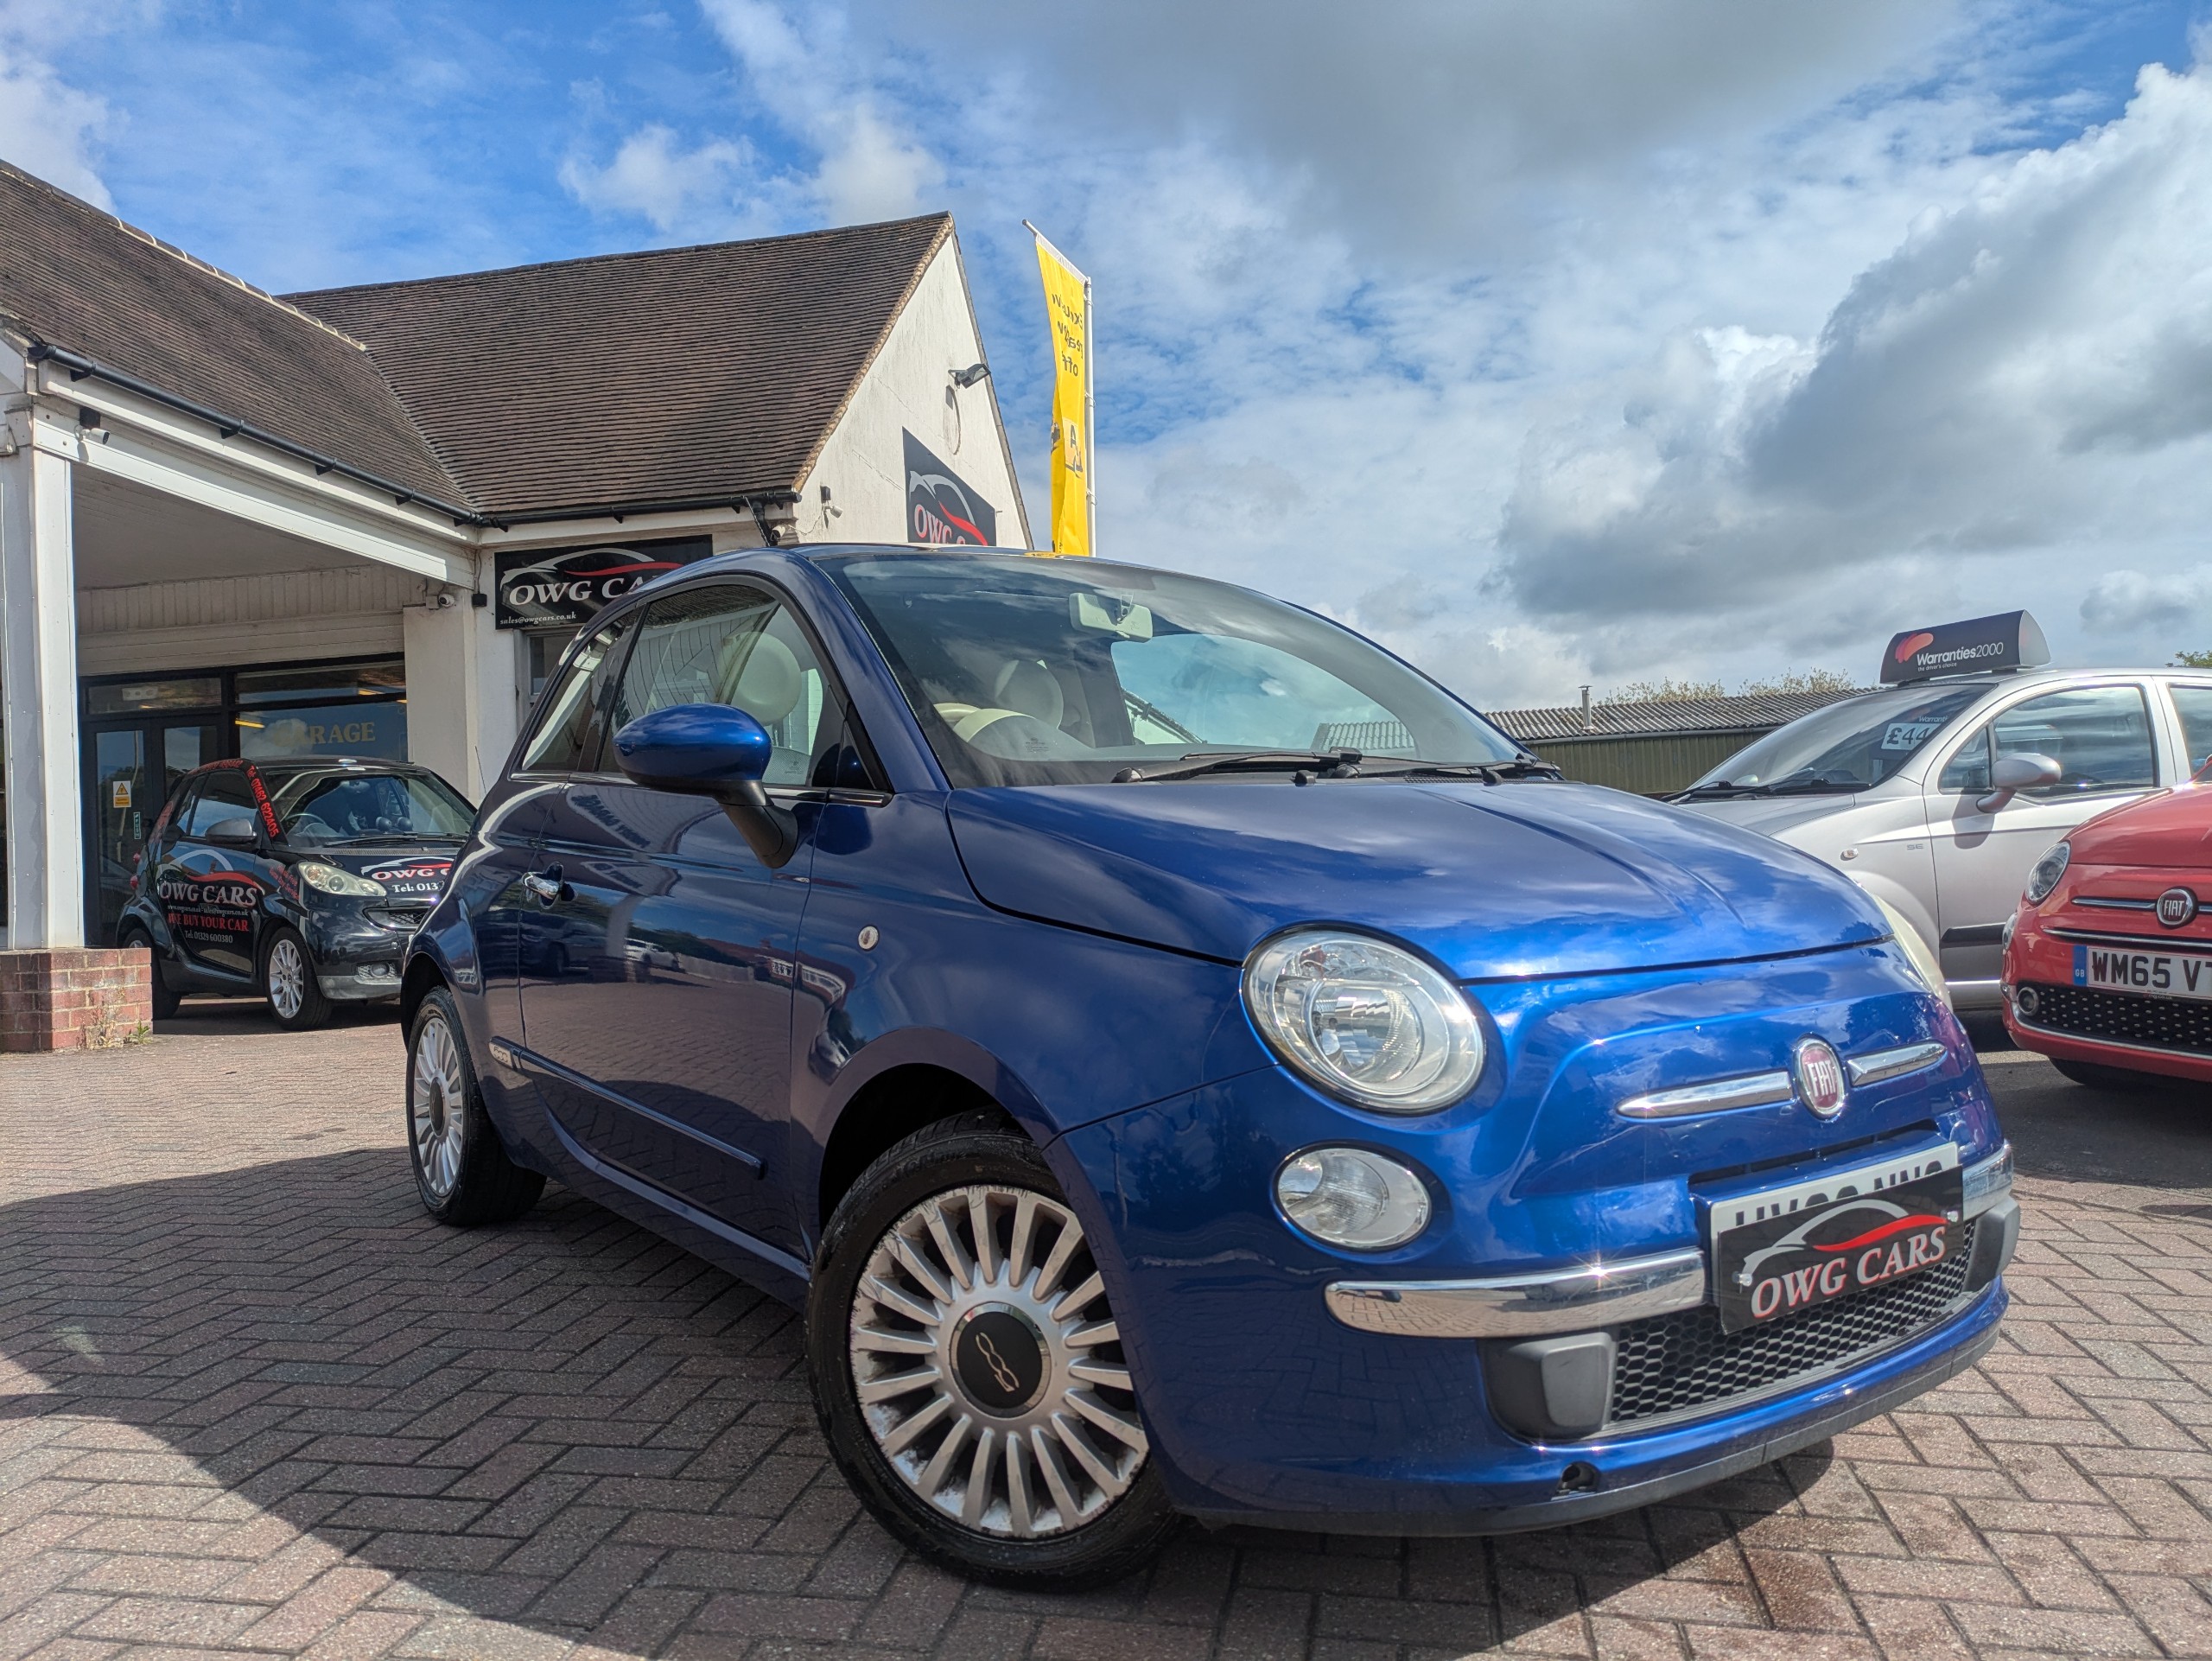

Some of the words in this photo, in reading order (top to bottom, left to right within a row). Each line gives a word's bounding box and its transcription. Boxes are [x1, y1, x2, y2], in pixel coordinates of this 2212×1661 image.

[509, 580, 593, 605] OWG
[601, 575, 658, 598] CA
[499, 611, 576, 625] sales@owgcars.co.uk
[1916, 642, 2004, 666] Warranties2000
[251, 779, 266, 803] 07462
[260, 802, 279, 837] 622405
[372, 869, 435, 881] OWG
[391, 882, 415, 893] Tel:
[416, 881, 440, 891] 013
[160, 882, 200, 902] OWG
[202, 886, 257, 907] CARS
[2164, 900, 2184, 917] FIAT
[168, 913, 181, 925] WE
[183, 914, 200, 926] BUY
[200, 916, 226, 930] YOUR
[227, 918, 249, 932] CAR
[2092, 951, 2171, 989] WM65
[1807, 1060, 1836, 1097] FIAT
[1751, 1257, 1847, 1319] OWG
[1857, 1225, 1947, 1285] CARS
